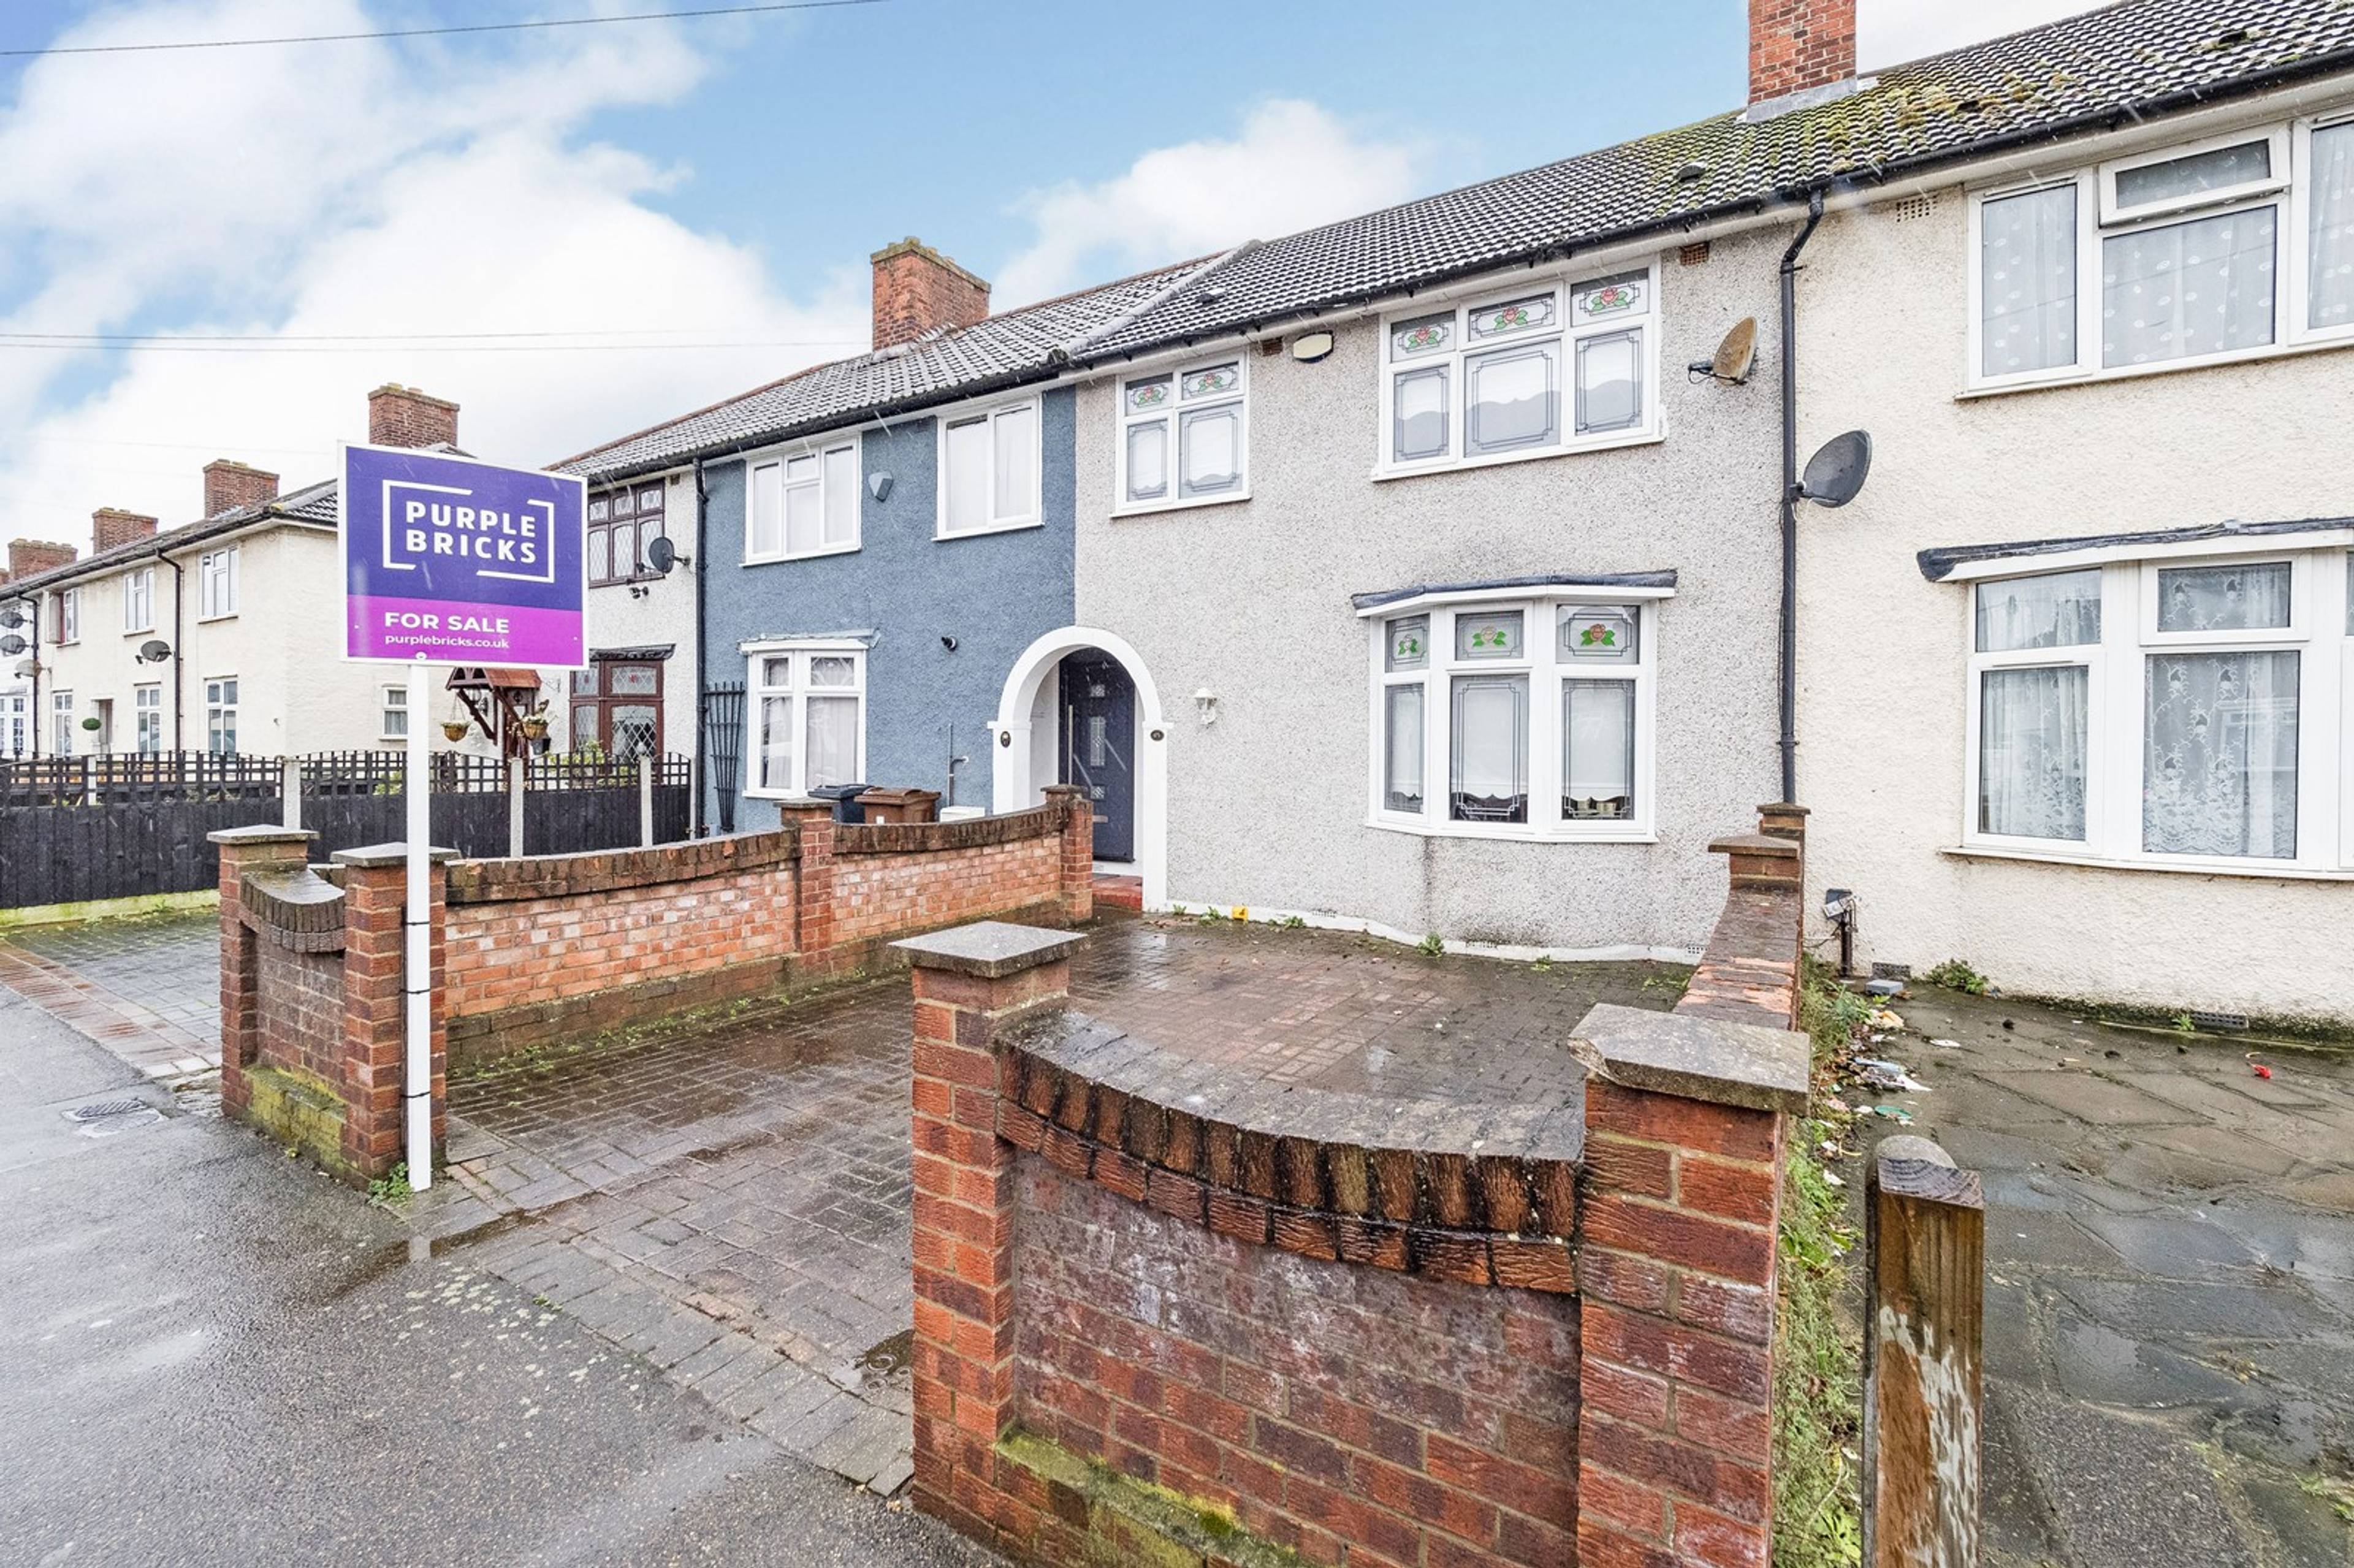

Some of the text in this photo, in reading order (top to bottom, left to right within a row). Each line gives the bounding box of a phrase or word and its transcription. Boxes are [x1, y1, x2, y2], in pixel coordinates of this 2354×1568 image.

[406, 501, 536, 538] PURPLE
[406, 529, 536, 563] BRICKS
[385, 612, 509, 634] FOR SALE
[385, 635, 510, 649] purplebricks.co.uk
